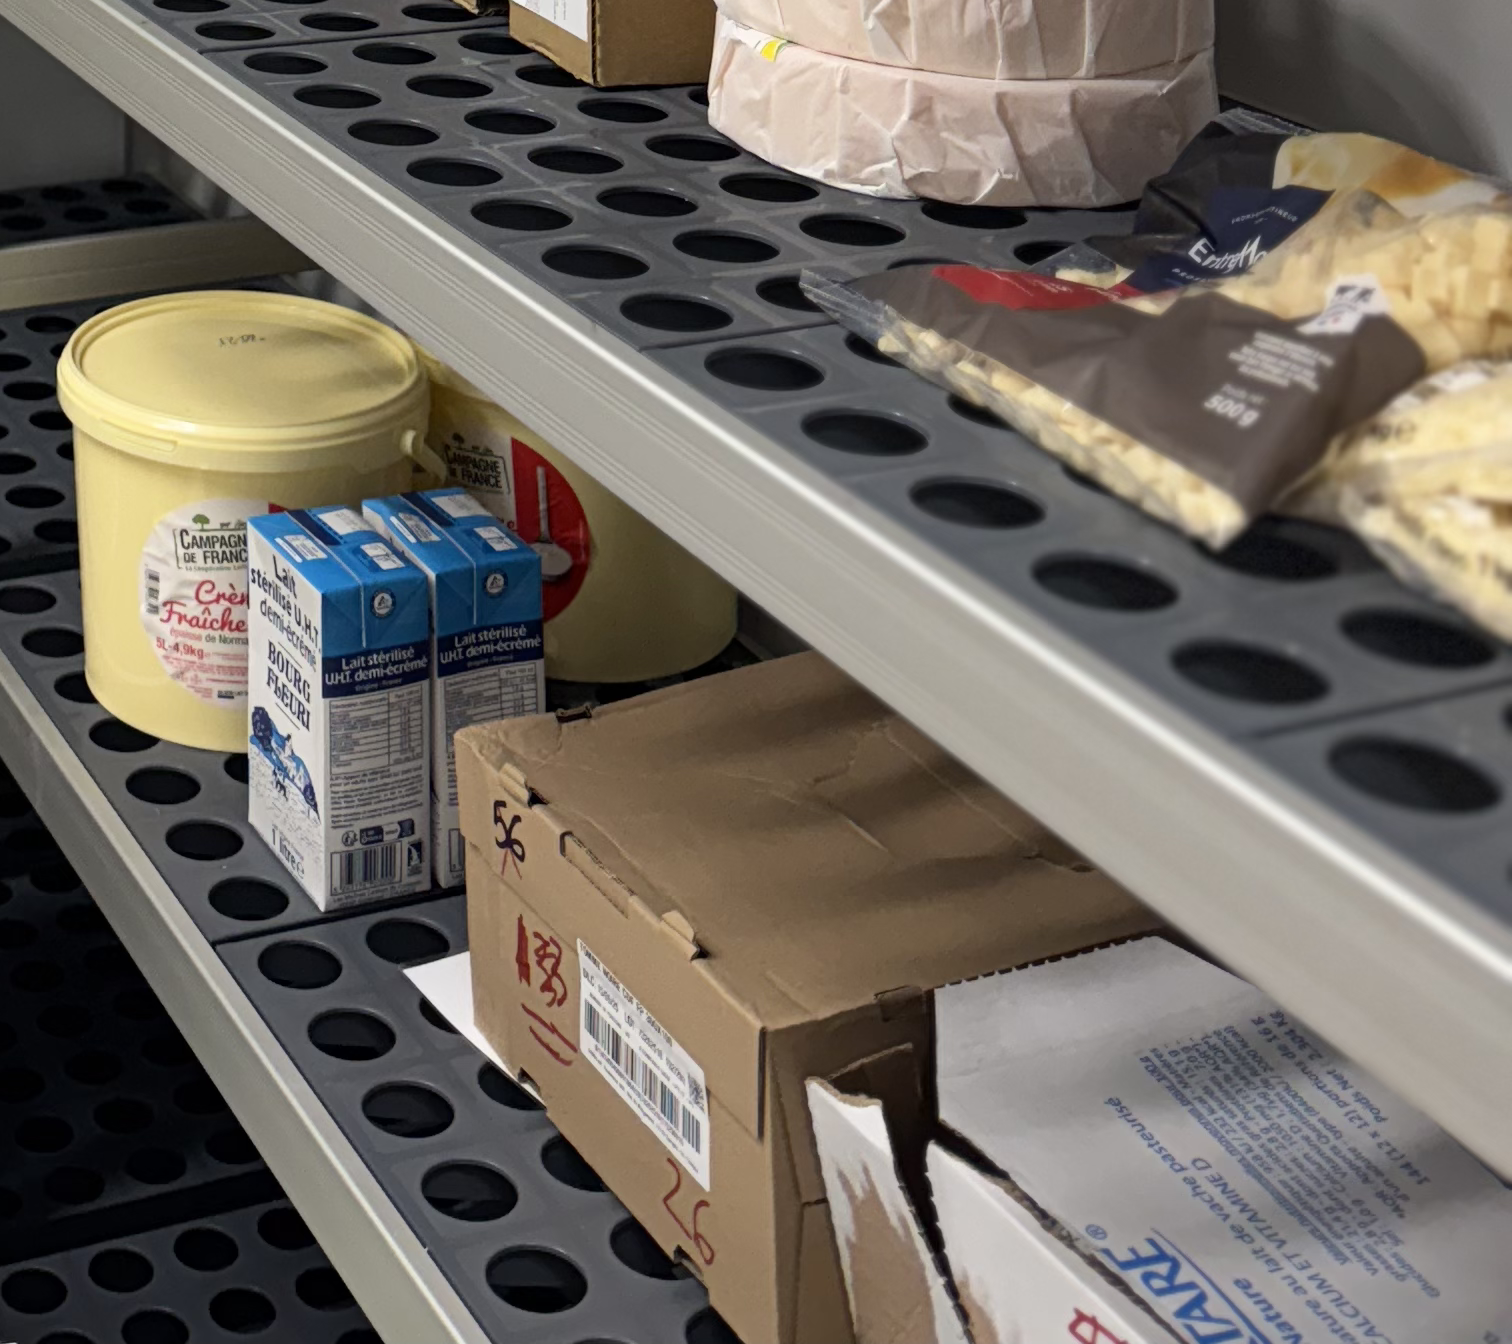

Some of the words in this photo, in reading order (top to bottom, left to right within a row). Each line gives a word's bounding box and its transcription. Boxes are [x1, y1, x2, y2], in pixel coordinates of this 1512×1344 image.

[179, 528, 247, 550] CAMPAGN
[184, 551, 197, 564] DE
[203, 548, 248, 564] FRANC
[272, 553, 297, 599] Lait
[251, 567, 292, 613] stérilisé
[160, 600, 248, 633] Fraîche
[205, 633, 217, 644] de
[219, 633, 249, 646] Norma
[453, 632, 477, 648] Lait
[478, 623, 528, 640] stérilisé
[267, 638, 311, 704] BOURG
[341, 653, 366, 671] Lait
[367, 646, 416, 666] stérilisé
[354, 655, 428, 682] demi-écrémé
[266, 665, 310, 732] FLEURI
[1293, 1061, 1351, 1108] portions
[1102, 1099, 1188, 1173] pasteurisé
[1188, 1157, 1213, 1170] D
[1178, 1177, 1232, 1220] vache
[1203, 1172, 1288, 1245] VITAMINE
[1225, 1225, 1256, 1244] de
[1247, 1247, 1284, 1272] lait
[1282, 1251, 1313, 1270] ET
[1100, 1233, 1274, 1344] TARE
[1277, 1275, 1308, 1295] au
